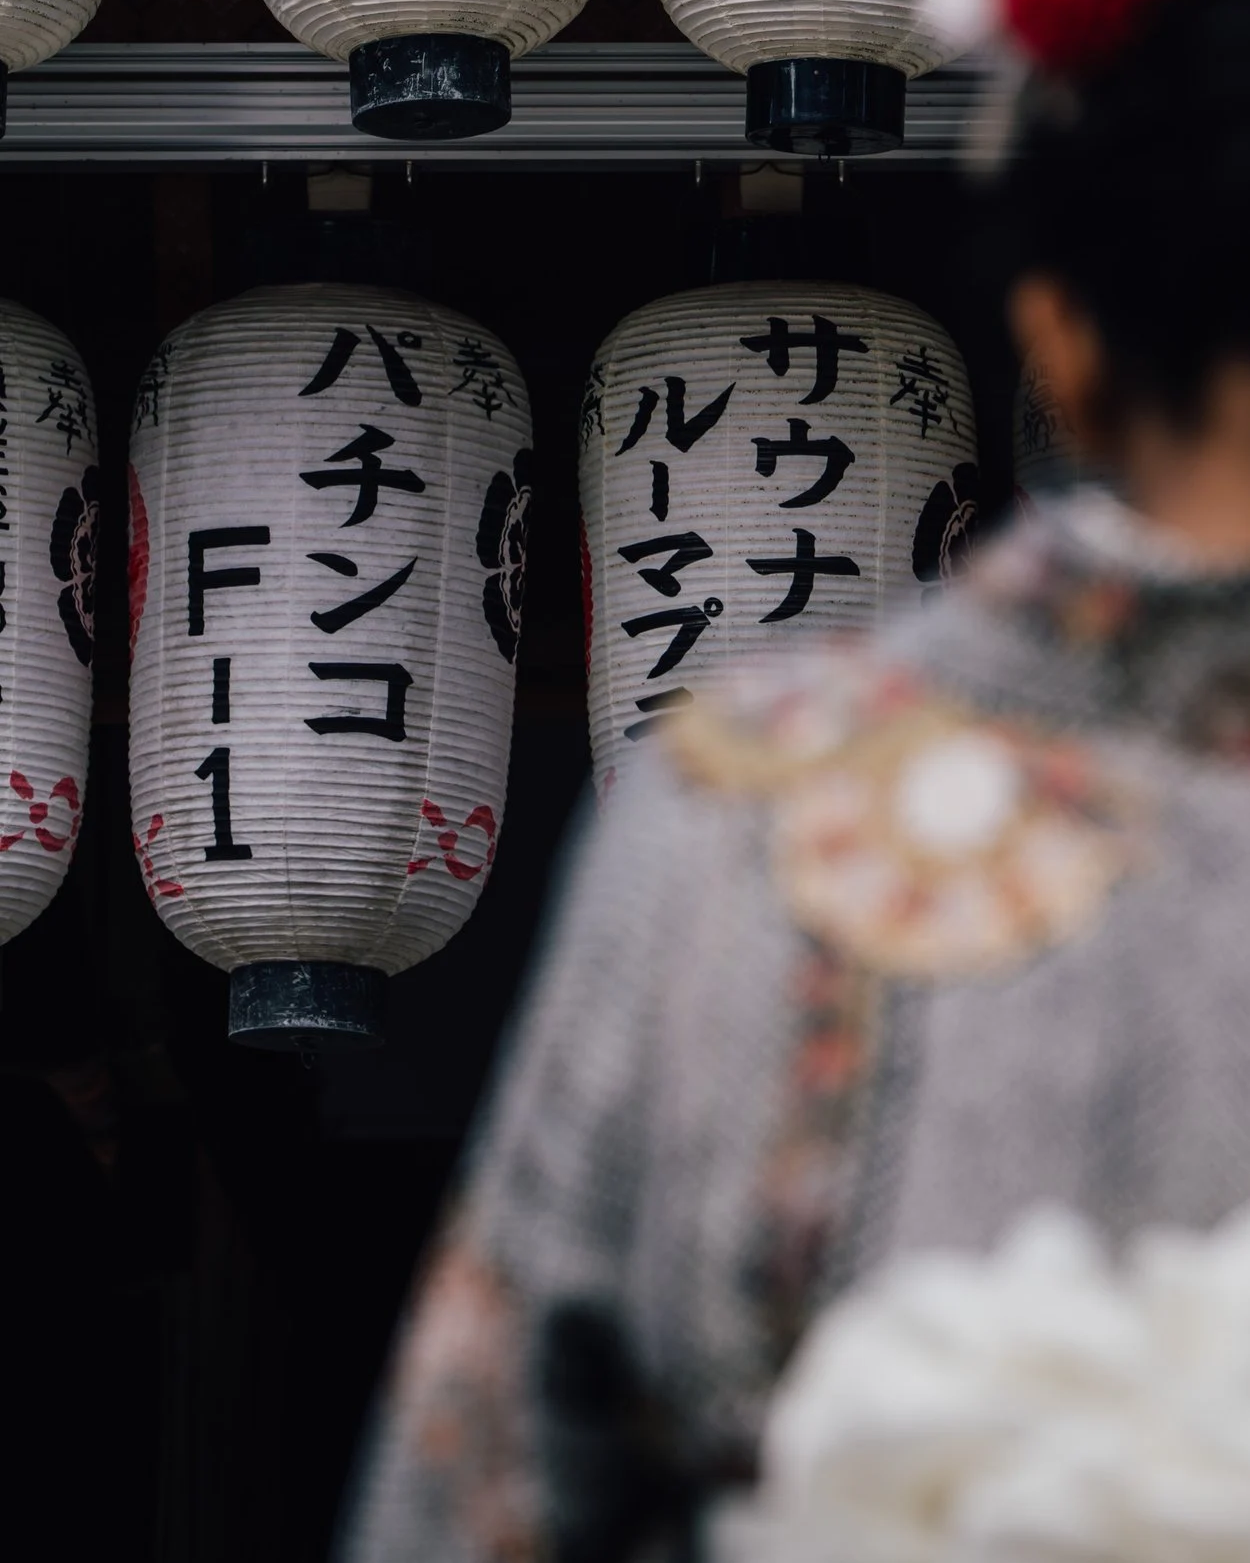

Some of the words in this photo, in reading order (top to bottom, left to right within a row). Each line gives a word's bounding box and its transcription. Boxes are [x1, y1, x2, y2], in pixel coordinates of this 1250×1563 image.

[298, 323, 427, 743] パチンコ
[739, 313, 871, 625] サウナ
